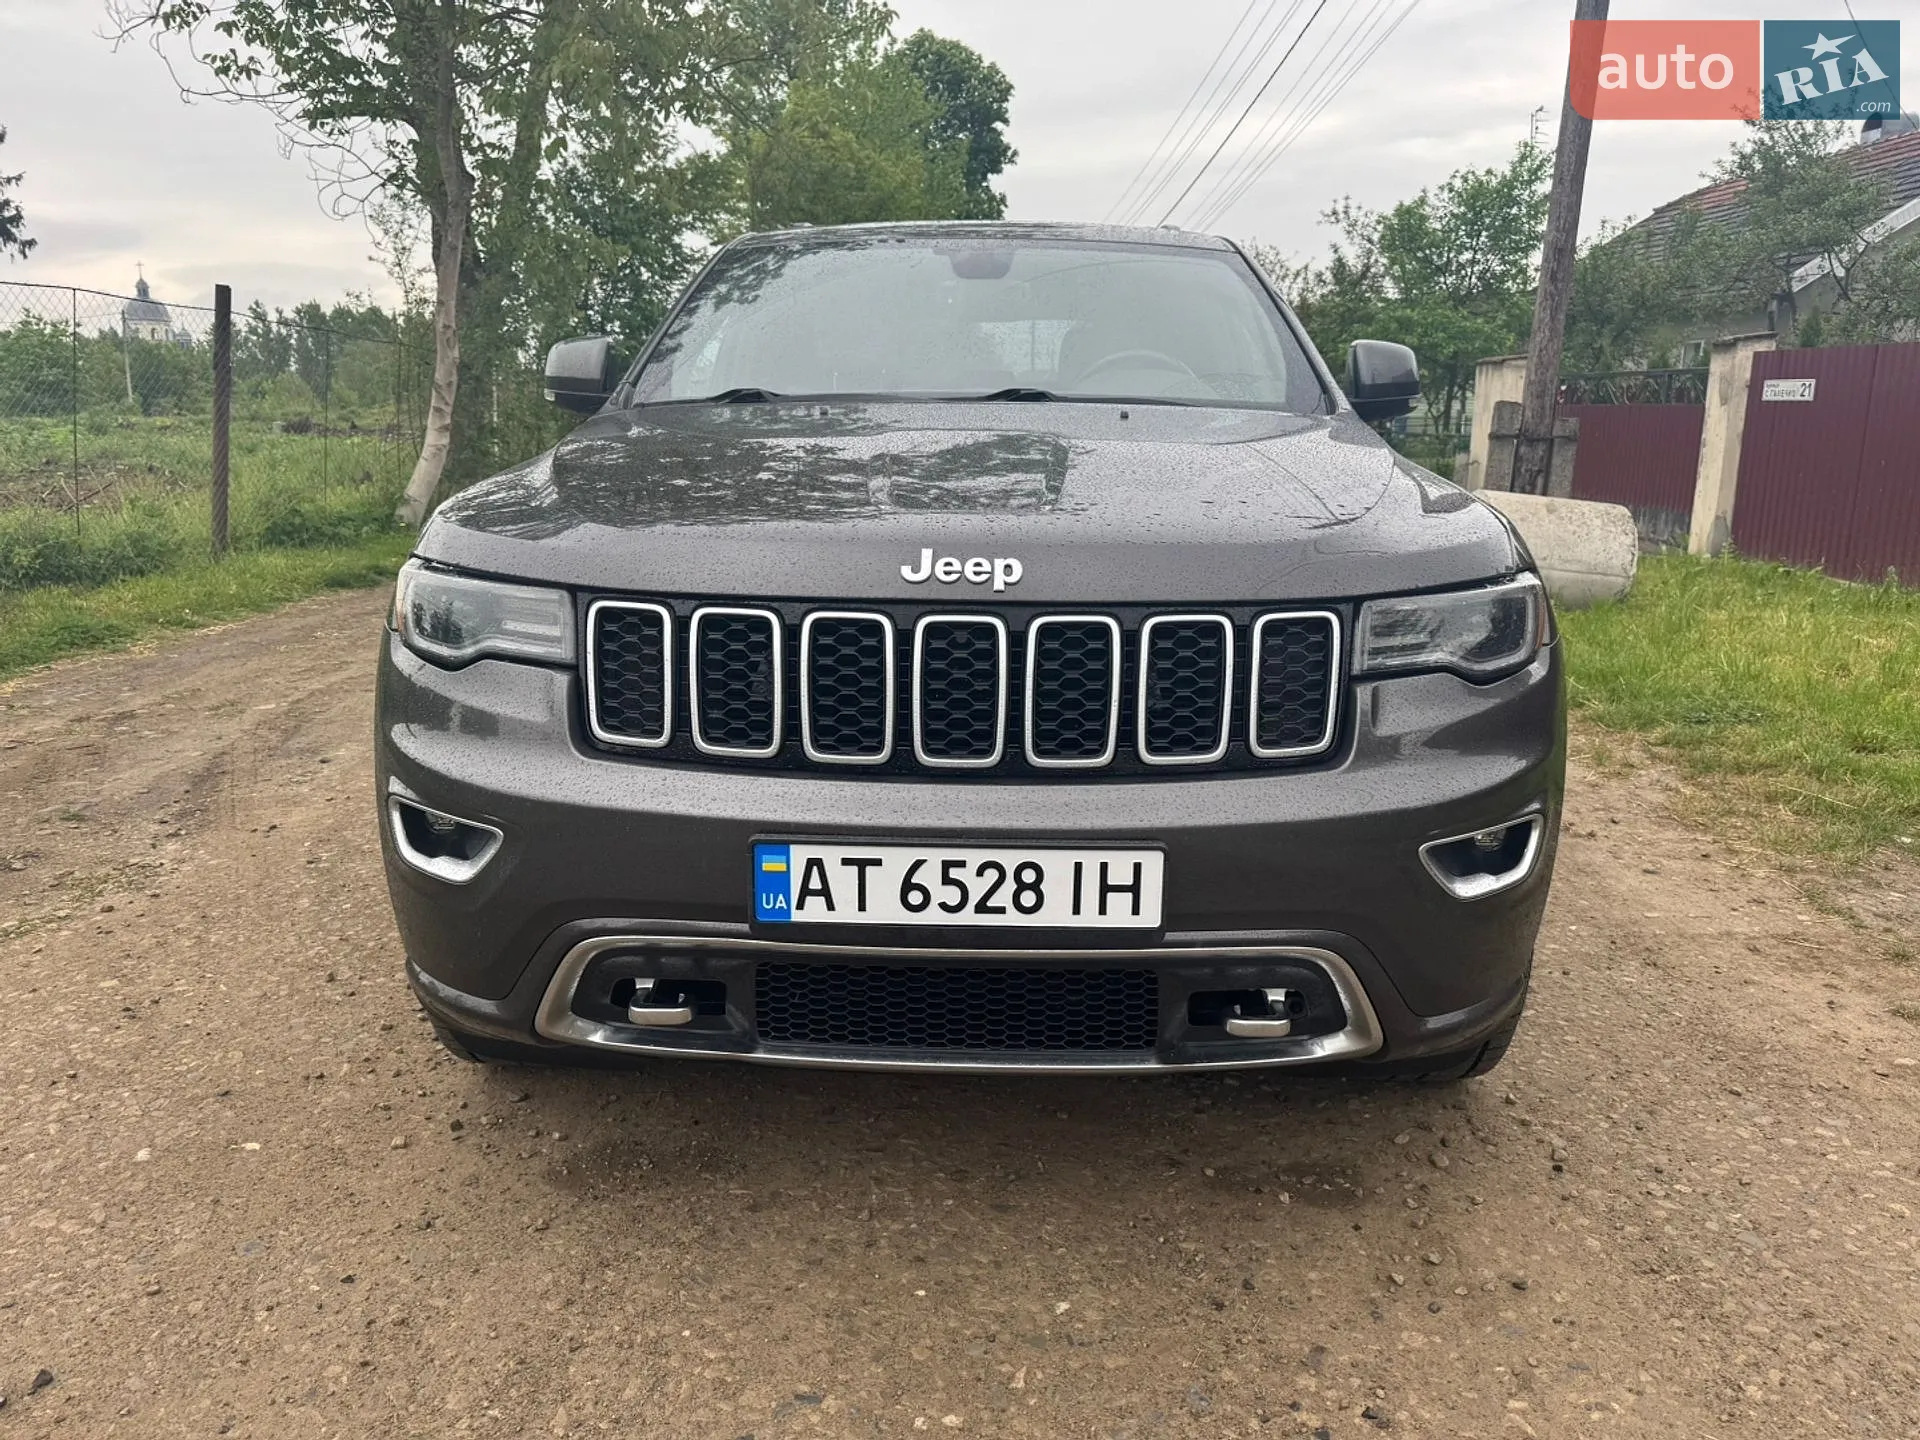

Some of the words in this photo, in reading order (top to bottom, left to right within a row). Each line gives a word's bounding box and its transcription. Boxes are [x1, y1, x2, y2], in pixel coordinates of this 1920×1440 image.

[1800, 382, 1812, 397] 21
[900, 548, 1023, 592] Jeep
[762, 893, 787, 909] UA
[796, 857, 882, 912] AT
[900, 859, 1045, 915] 6528
[1072, 861, 1142, 916] IH
